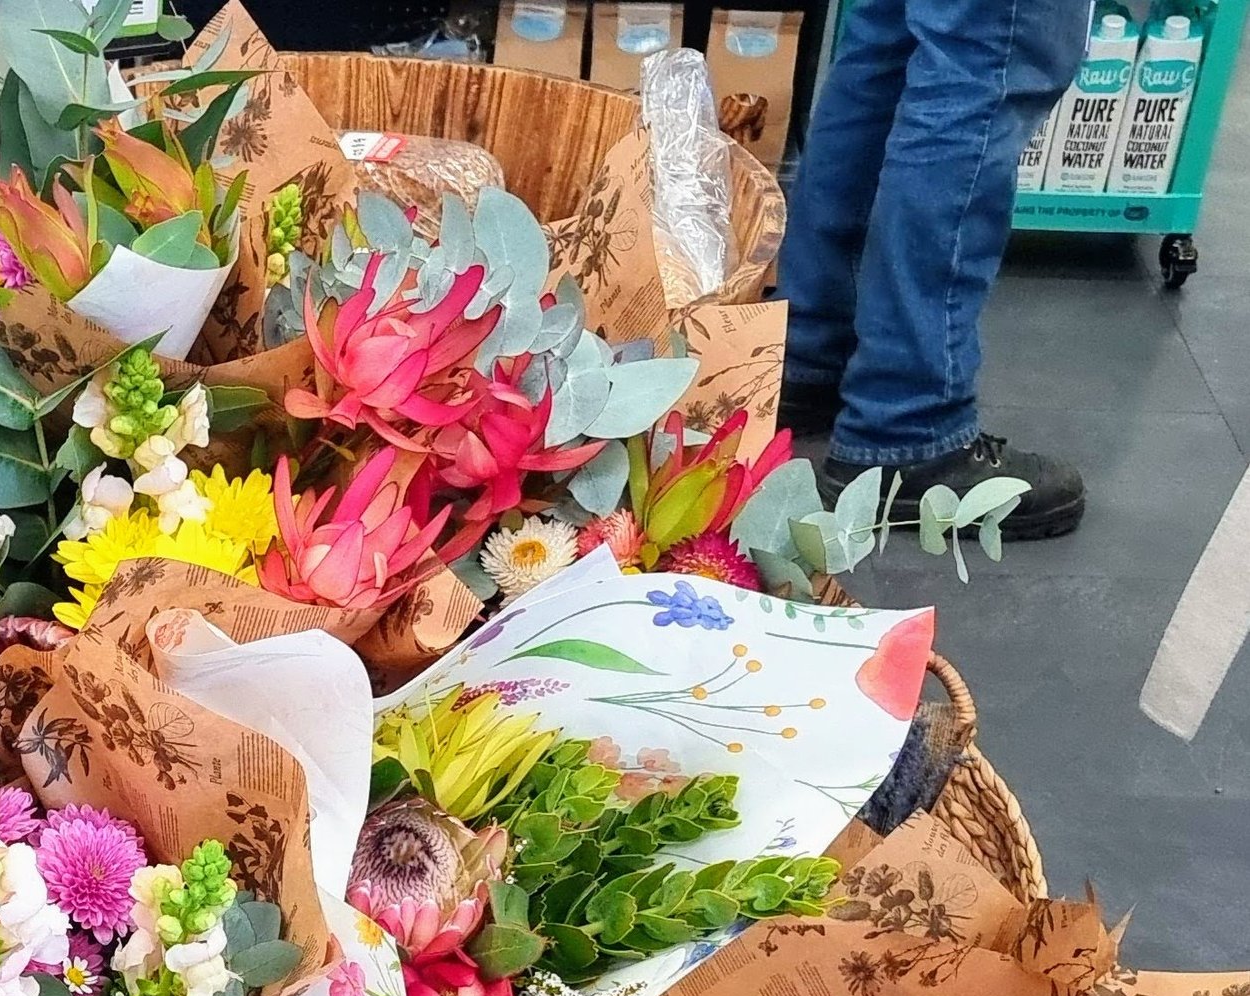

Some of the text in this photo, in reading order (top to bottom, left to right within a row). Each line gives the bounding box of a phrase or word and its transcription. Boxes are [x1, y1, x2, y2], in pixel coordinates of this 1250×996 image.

[1080, 66, 1116, 87] Raw
[1142, 66, 1179, 87] Raw
[1071, 98, 1118, 122] PURE
[1133, 98, 1179, 122] PURE
[1066, 123, 1110, 139] NATURAL
[1129, 123, 1173, 140] NATURAL
[1064, 140, 1107, 152] COCONUT
[1126, 140, 1169, 153] COCONUT
[1061, 151, 1105, 168] WATER
[1123, 152, 1167, 169] WATER
[208, 757, 222, 785] Plante
